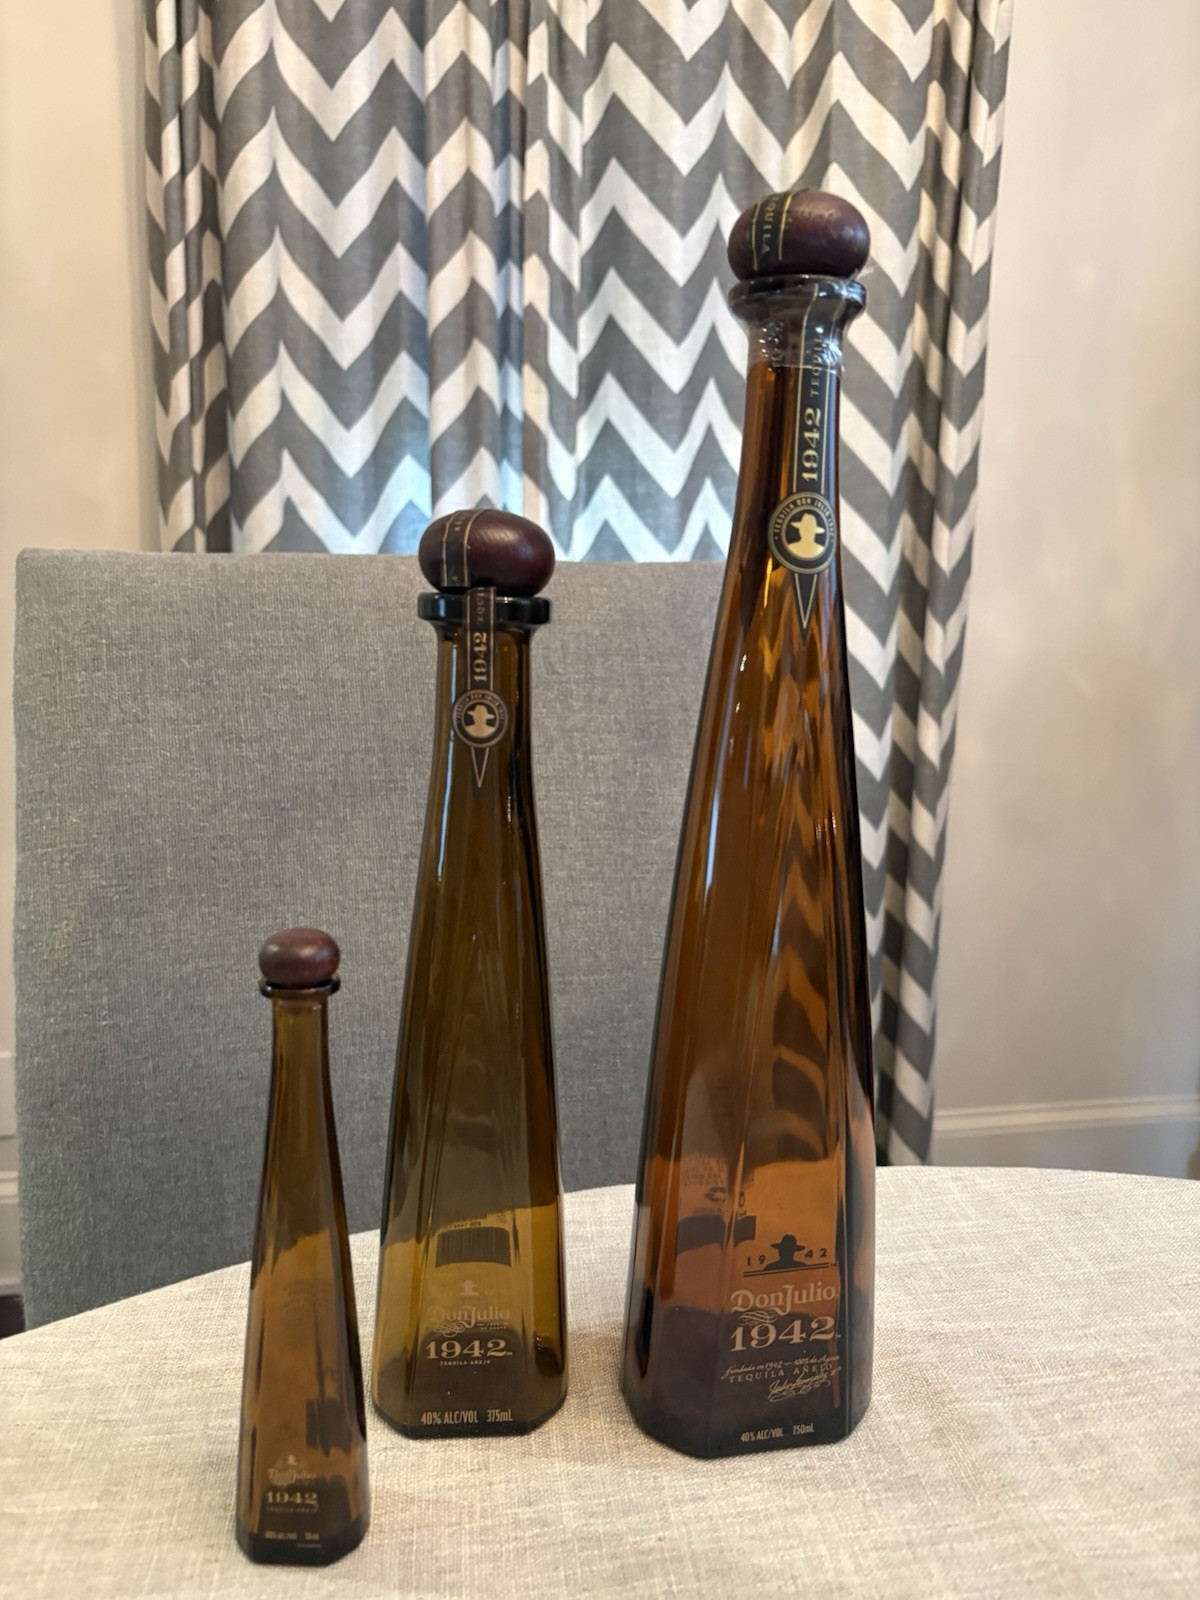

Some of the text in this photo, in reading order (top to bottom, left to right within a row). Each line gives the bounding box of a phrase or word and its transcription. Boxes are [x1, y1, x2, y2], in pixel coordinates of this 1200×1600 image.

[801, 407, 822, 482] 1942
[472, 631, 488, 683] 1942
[730, 1316, 836, 1352] 1942
[425, 1338, 507, 1359] 1942
[729, 1368, 785, 1384] TEQUILA
[421, 1408, 513, 1426] 40% ALC/VOL 375mL
